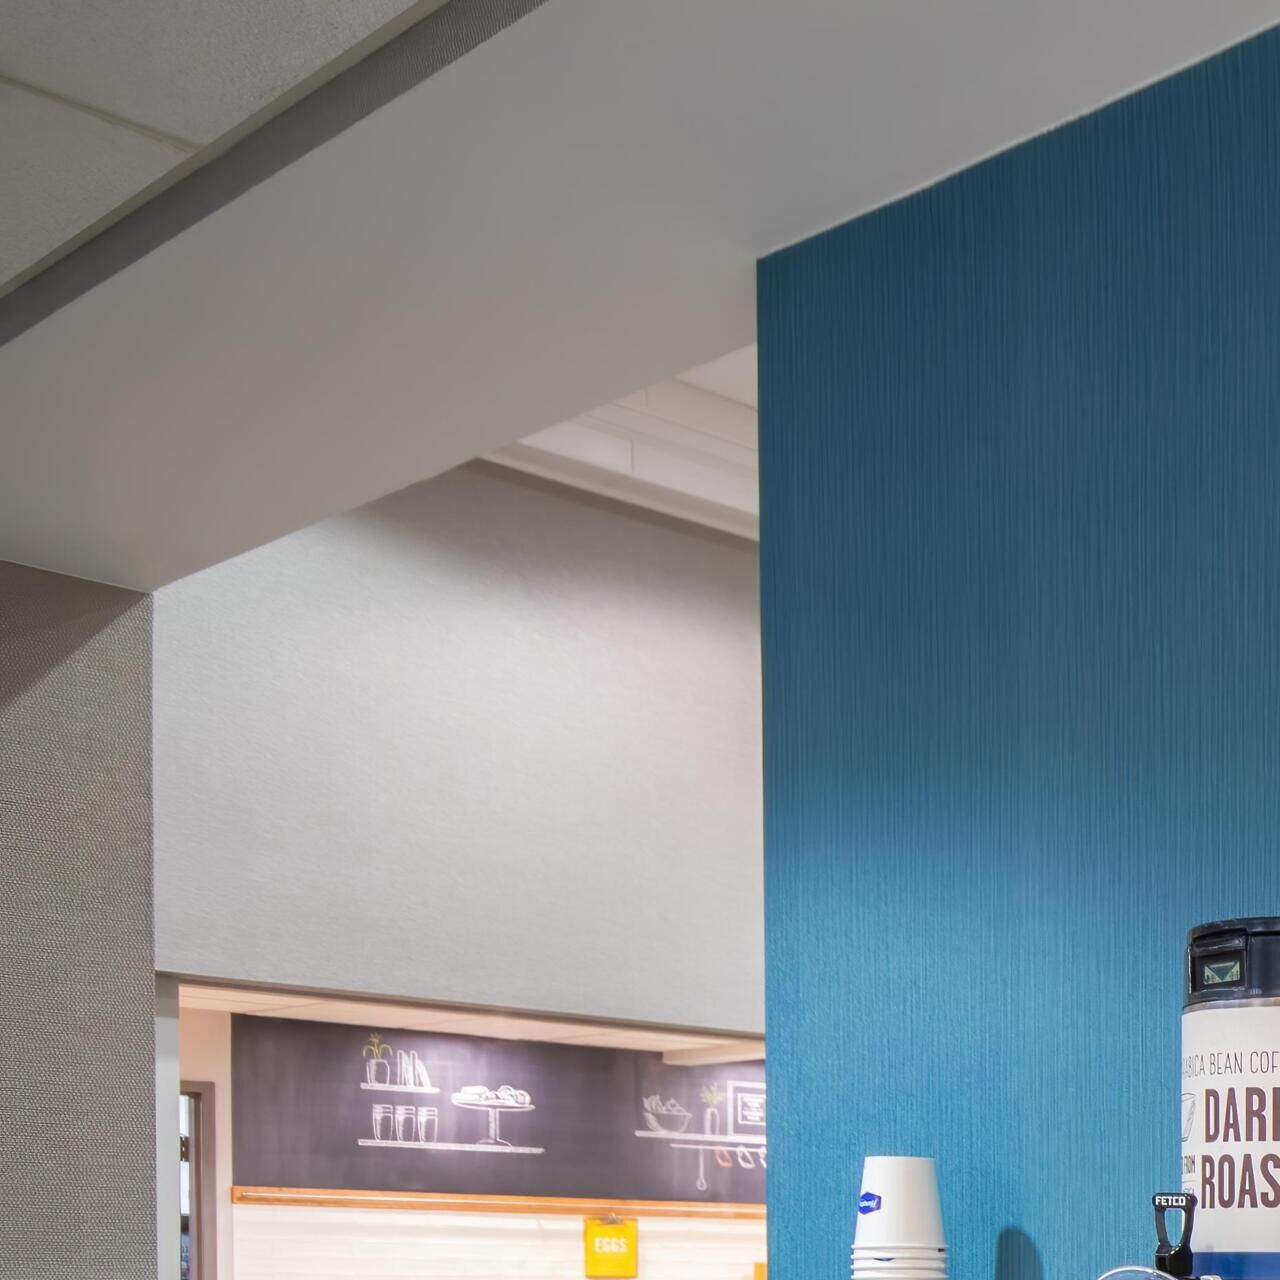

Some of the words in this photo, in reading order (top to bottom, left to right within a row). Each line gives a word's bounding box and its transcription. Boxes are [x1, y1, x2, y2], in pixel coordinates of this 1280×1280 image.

[1209, 1051, 1243, 1076] BEAN
[1154, 1195, 1187, 1207] FETCO
[594, 1237, 628, 1253] EGGS
